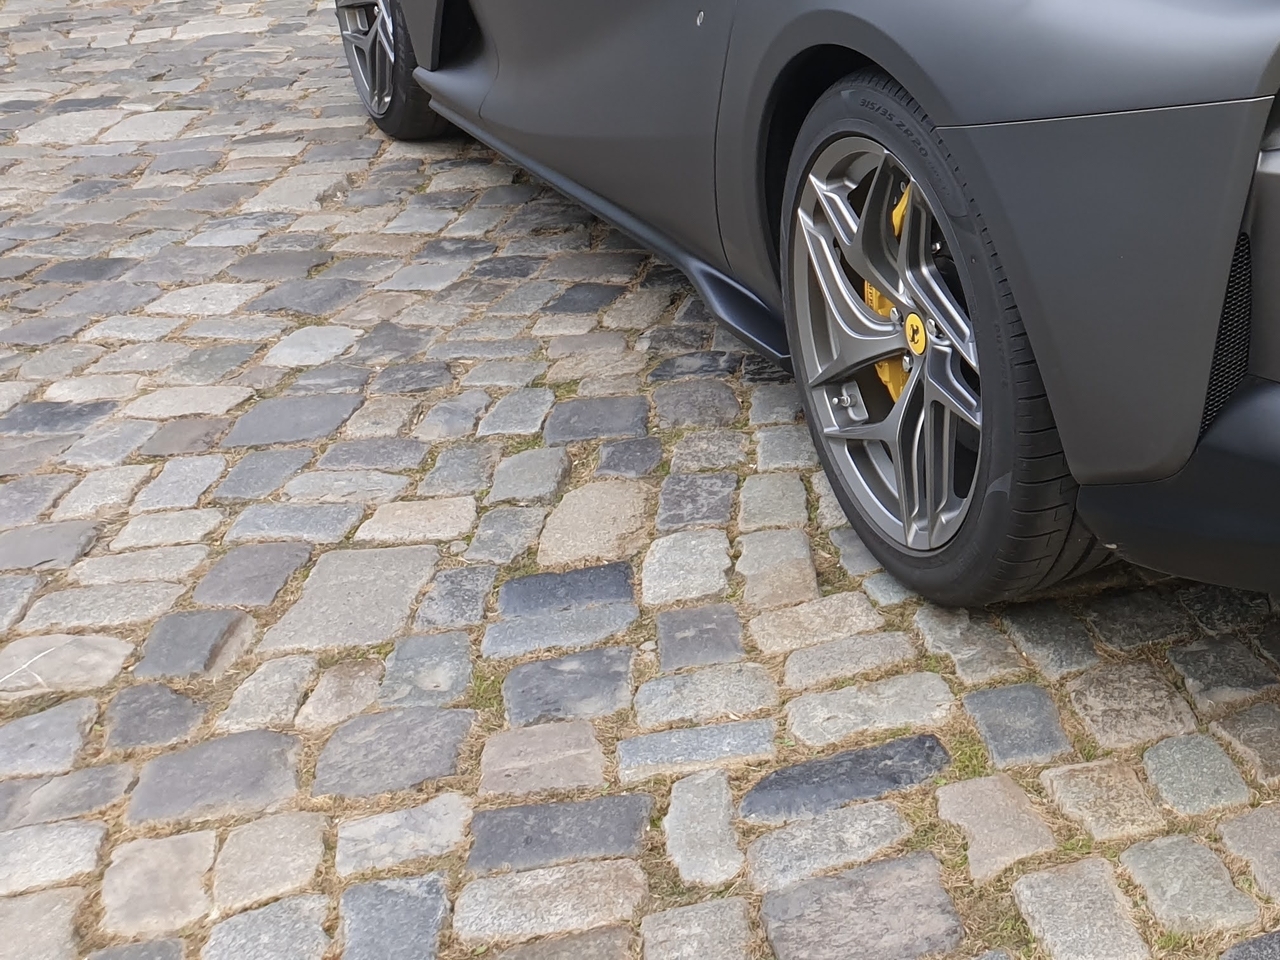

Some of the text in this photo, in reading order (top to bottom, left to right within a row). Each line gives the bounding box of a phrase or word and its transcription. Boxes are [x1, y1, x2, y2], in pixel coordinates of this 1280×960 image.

[860, 98, 928, 158] 315/35 ZR 20
